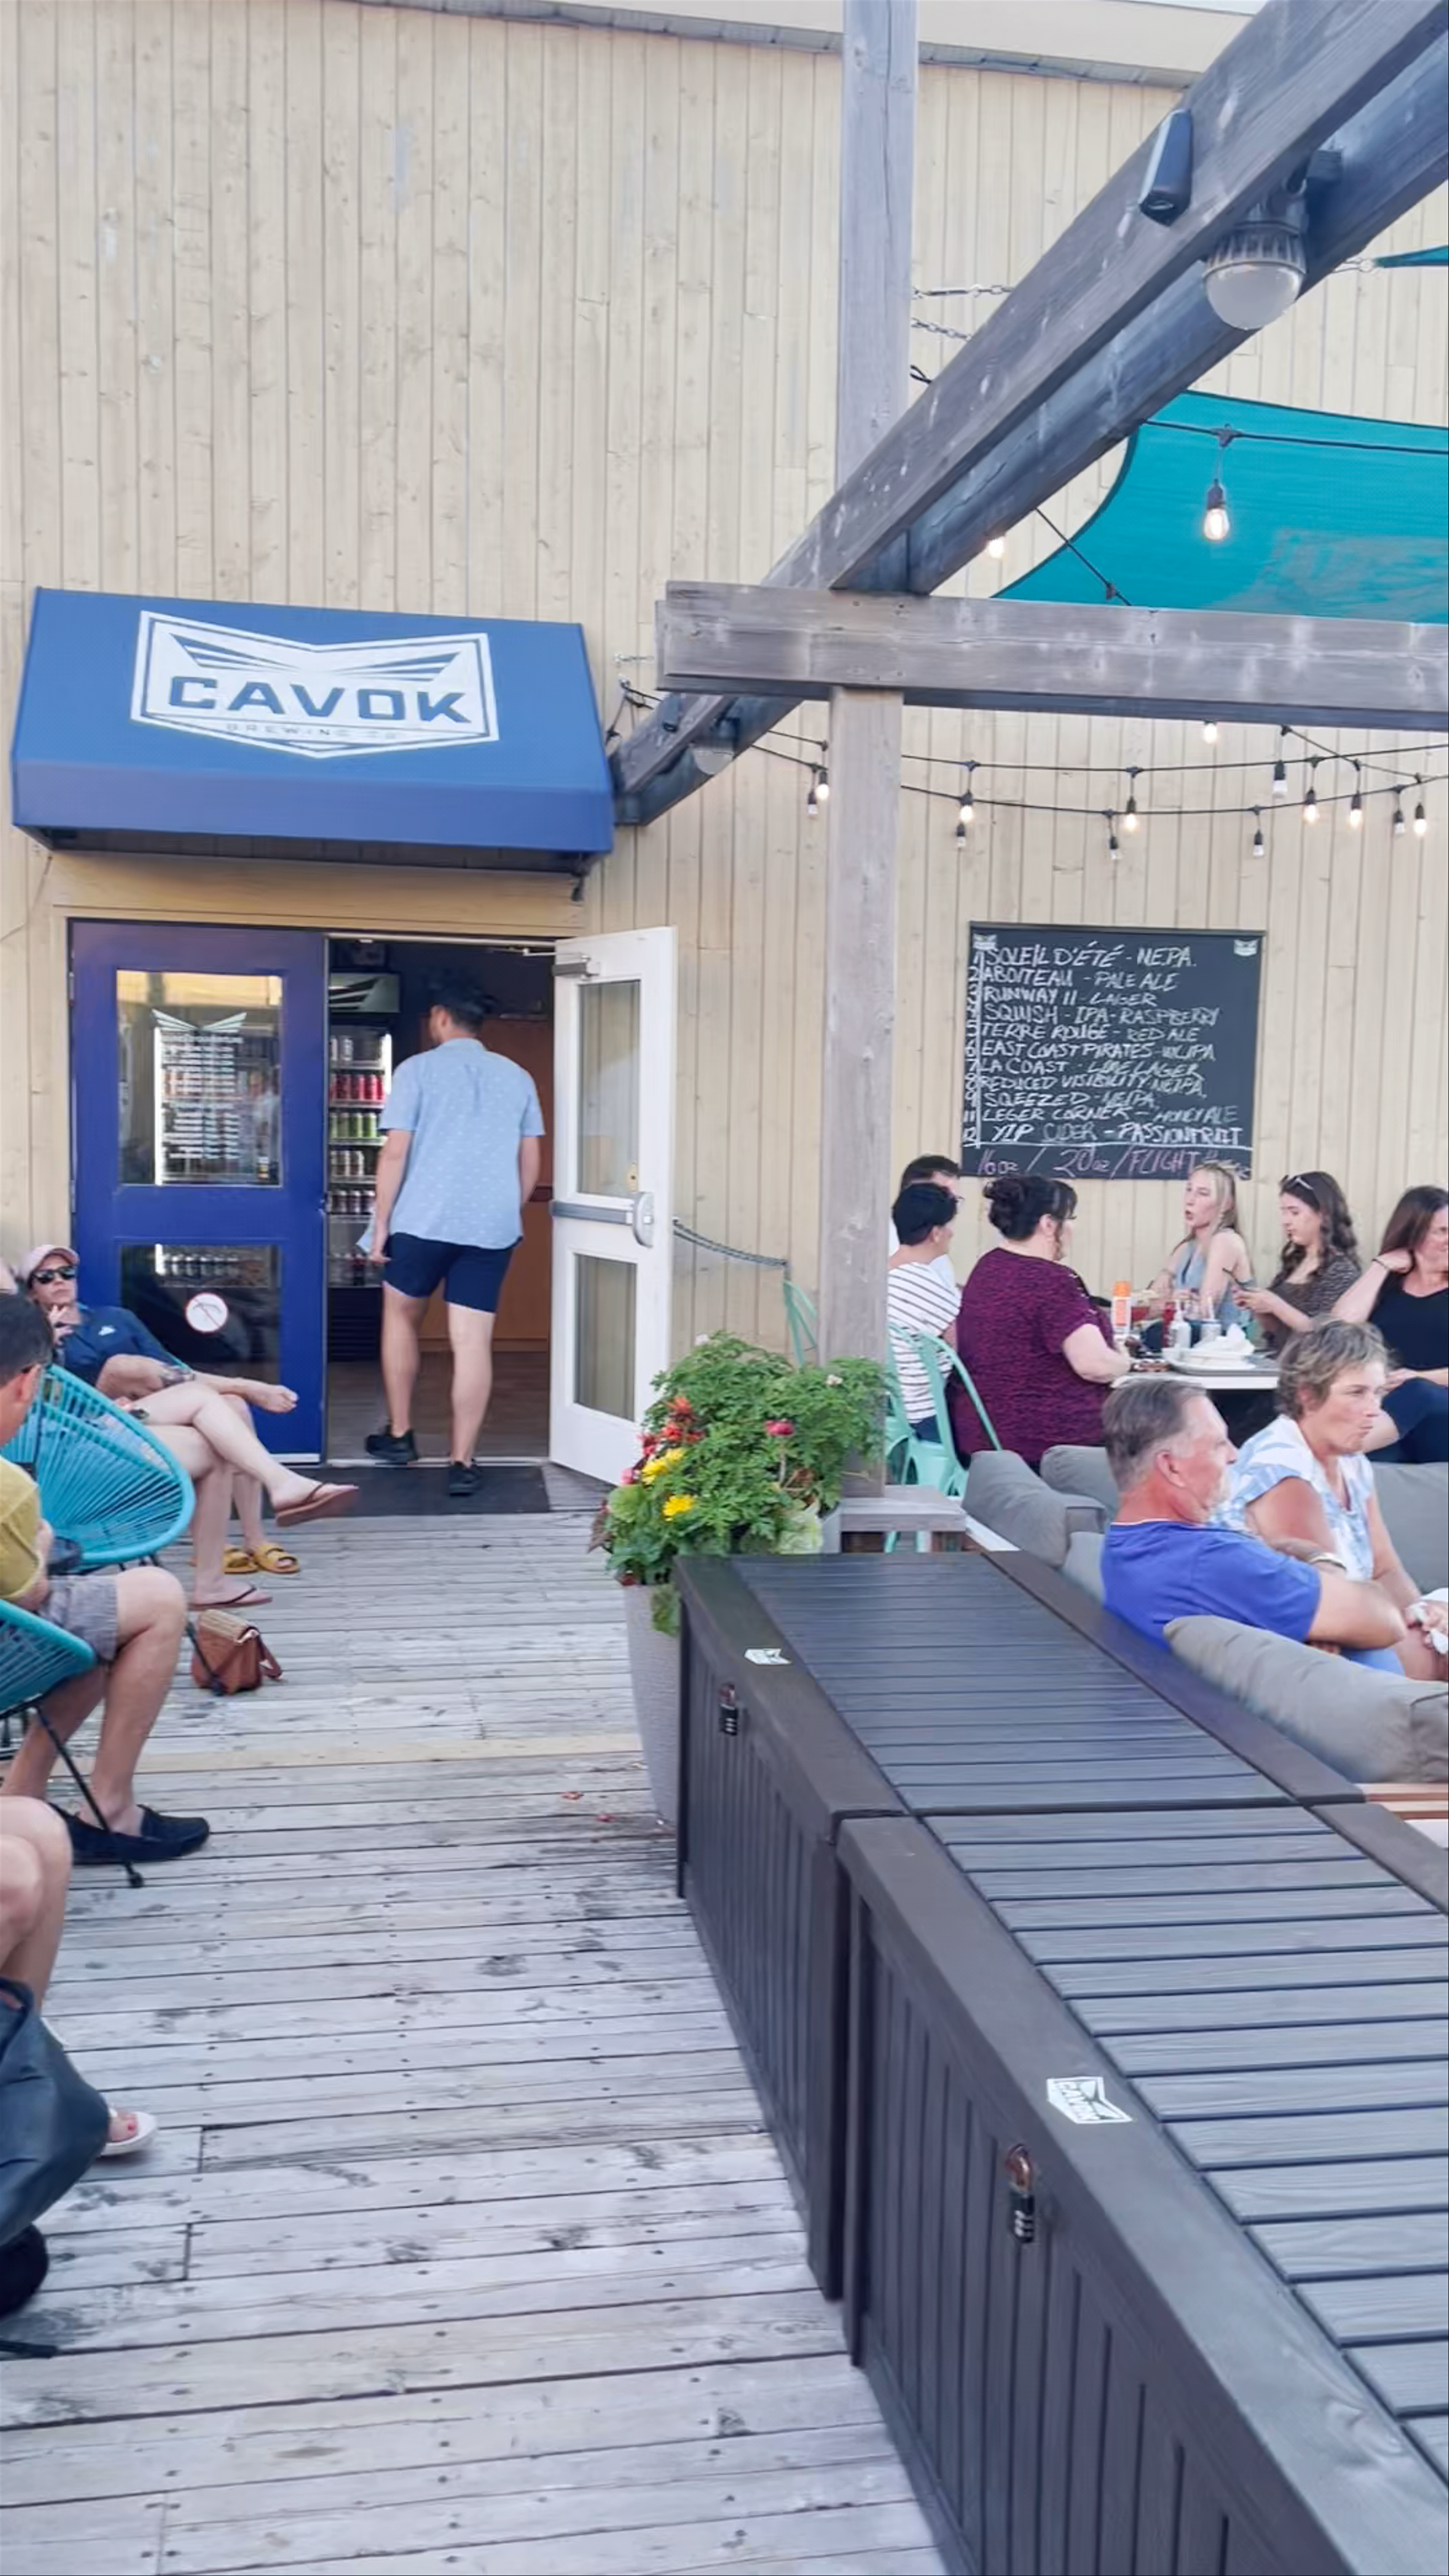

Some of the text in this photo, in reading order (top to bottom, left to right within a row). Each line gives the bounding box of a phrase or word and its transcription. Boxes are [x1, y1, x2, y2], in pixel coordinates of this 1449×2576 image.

[169, 676, 471, 724] CAVOK
[985, 944, 1050, 967] SOLEIL
[1095, 971, 1137, 989] PALE
[1138, 972, 1180, 992] ALE
[984, 986, 1058, 1004] RUNWAY
[1089, 991, 1158, 1007] LAGER
[983, 1002, 1058, 1025] SQUISH
[981, 1021, 1046, 1041] TERRE
[1127, 1027, 1165, 1042] RED
[1166, 1027, 1200, 1042] ALE
[981, 1039, 1027, 1056] EAST
[1027, 1042, 1081, 1059] COAST
[1081, 1042, 1156, 1060] PIRATES
[979, 1057, 1003, 1073] LA
[1005, 1057, 1070, 1075] COAST
[981, 1108, 1046, 1122] LEGER
[1051, 1104, 1134, 1121] CORNER
[1202, 1105, 1238, 1124] ALE
[991, 1123, 1035, 1142] YIP
